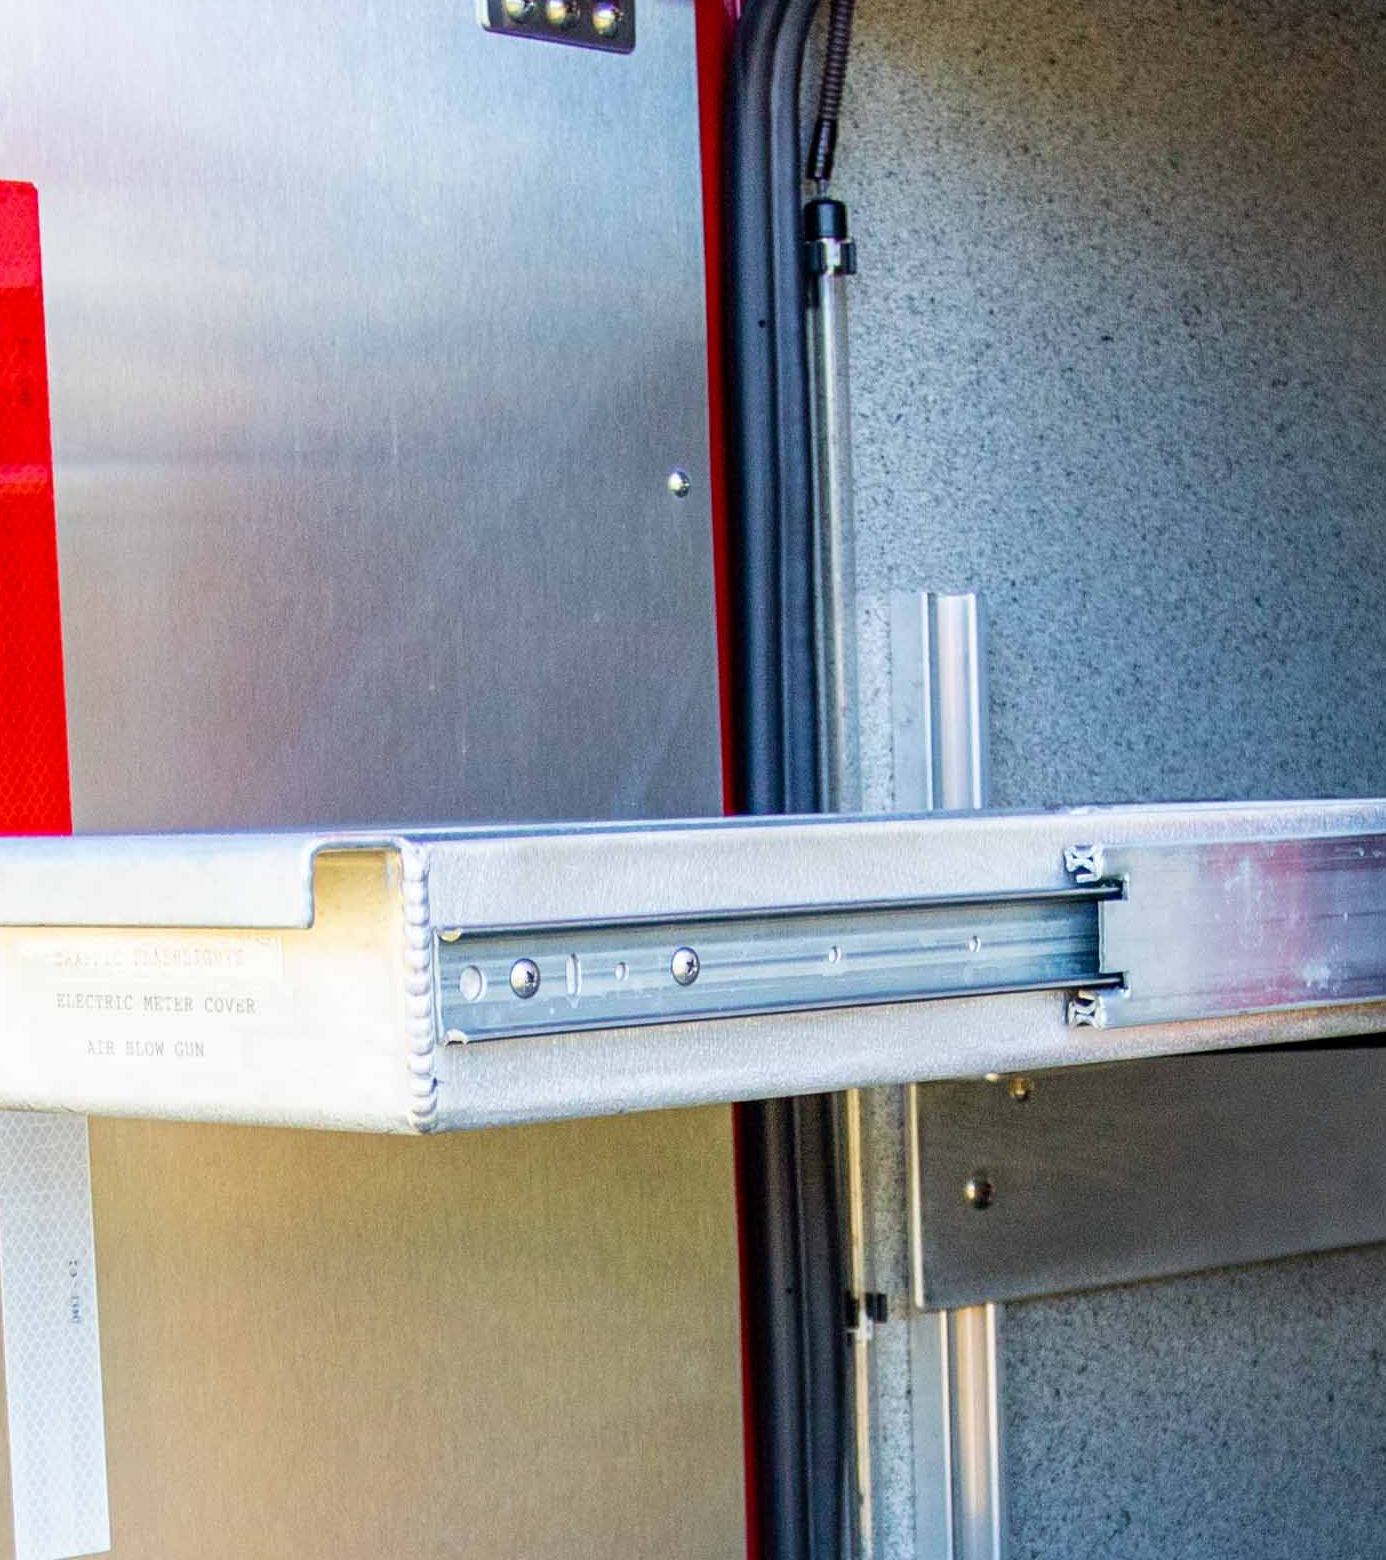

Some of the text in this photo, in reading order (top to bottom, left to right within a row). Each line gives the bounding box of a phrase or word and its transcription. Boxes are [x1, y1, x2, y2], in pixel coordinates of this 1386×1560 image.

[56, 992, 256, 1015] ELECTRIC METER COVER
[86, 1039, 205, 1058] AIR BLOW GUN
